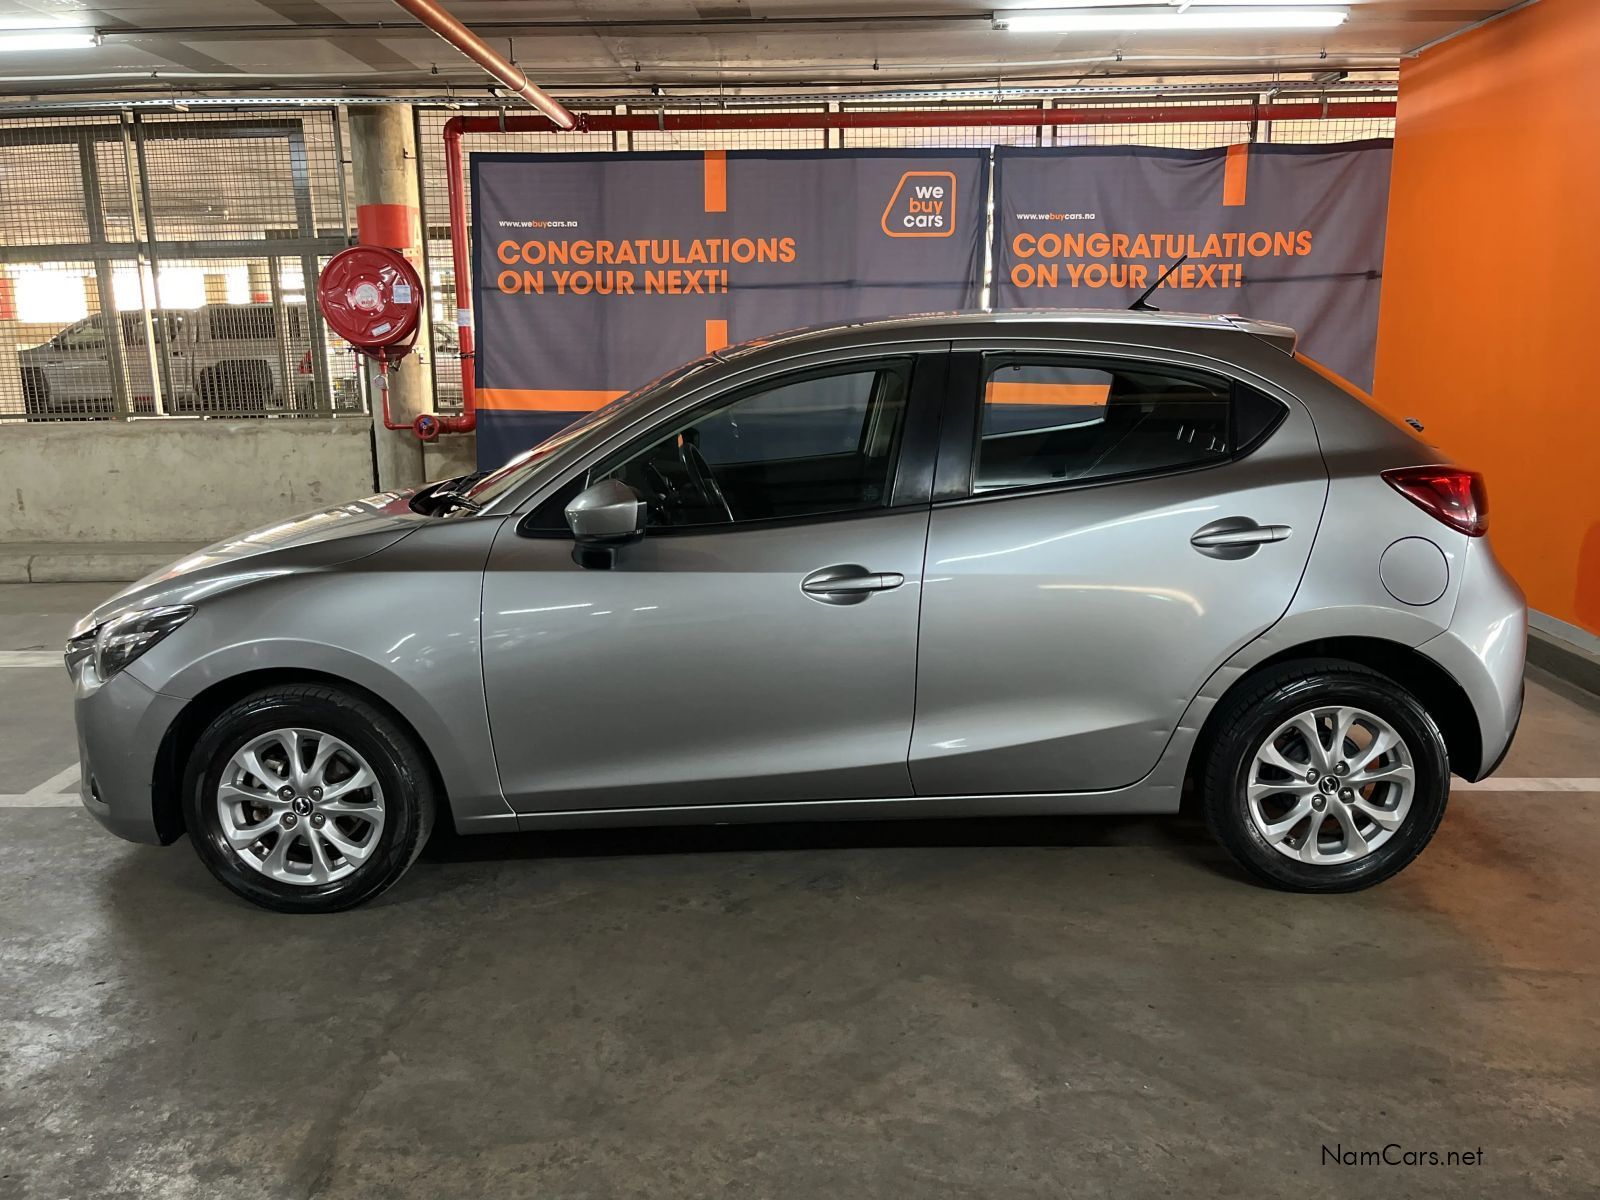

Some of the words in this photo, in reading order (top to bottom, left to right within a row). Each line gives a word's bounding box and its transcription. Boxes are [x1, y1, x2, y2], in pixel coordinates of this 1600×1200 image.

[915, 186, 944, 199] we
[909, 197, 944, 215] buy
[498, 219, 578, 229] www.webuycars.na
[903, 214, 943, 228] cars
[1016, 212, 1095, 221] www.webuycars.na
[497, 237, 796, 265] CONGRATULATIONS
[1012, 230, 1312, 259] CONGRATULATIONS
[497, 270, 544, 295] ON
[551, 270, 635, 295] YOUR
[644, 269, 728, 295] NEXT!
[1010, 263, 1059, 289] ON
[1065, 263, 1148, 289] YOUR
[1157, 263, 1242, 289] NEXT!
